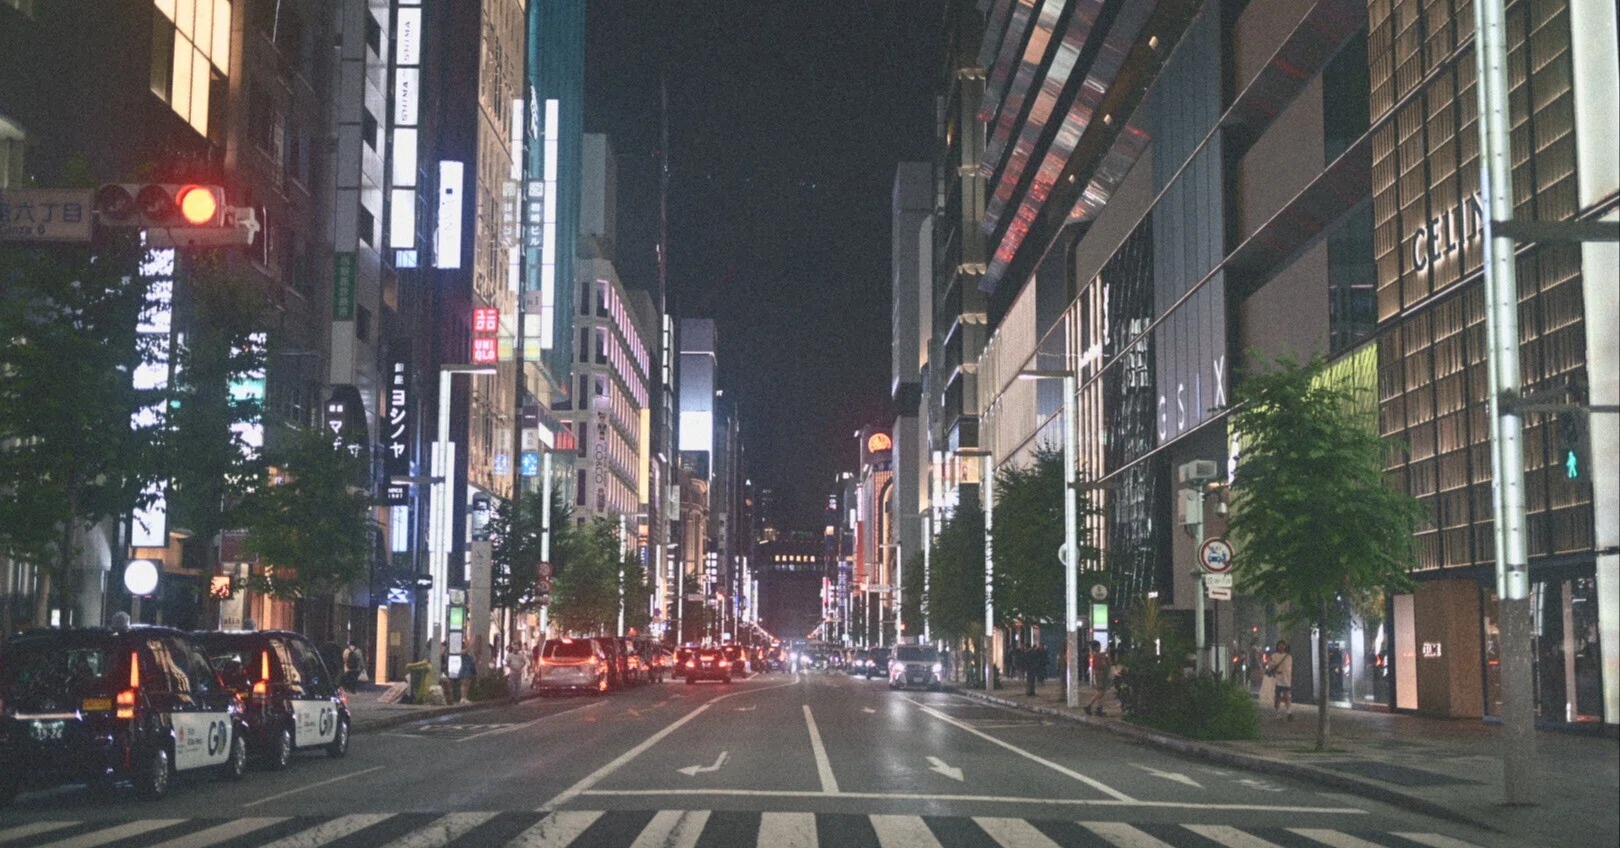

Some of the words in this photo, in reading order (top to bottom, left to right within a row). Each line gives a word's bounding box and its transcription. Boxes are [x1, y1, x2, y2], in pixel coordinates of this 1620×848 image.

[1413, 191, 1485, 271] CELIN
[475, 339, 494, 350] UNI
[475, 350, 495, 361] QLO
[1159, 354, 1227, 441] GSIX
